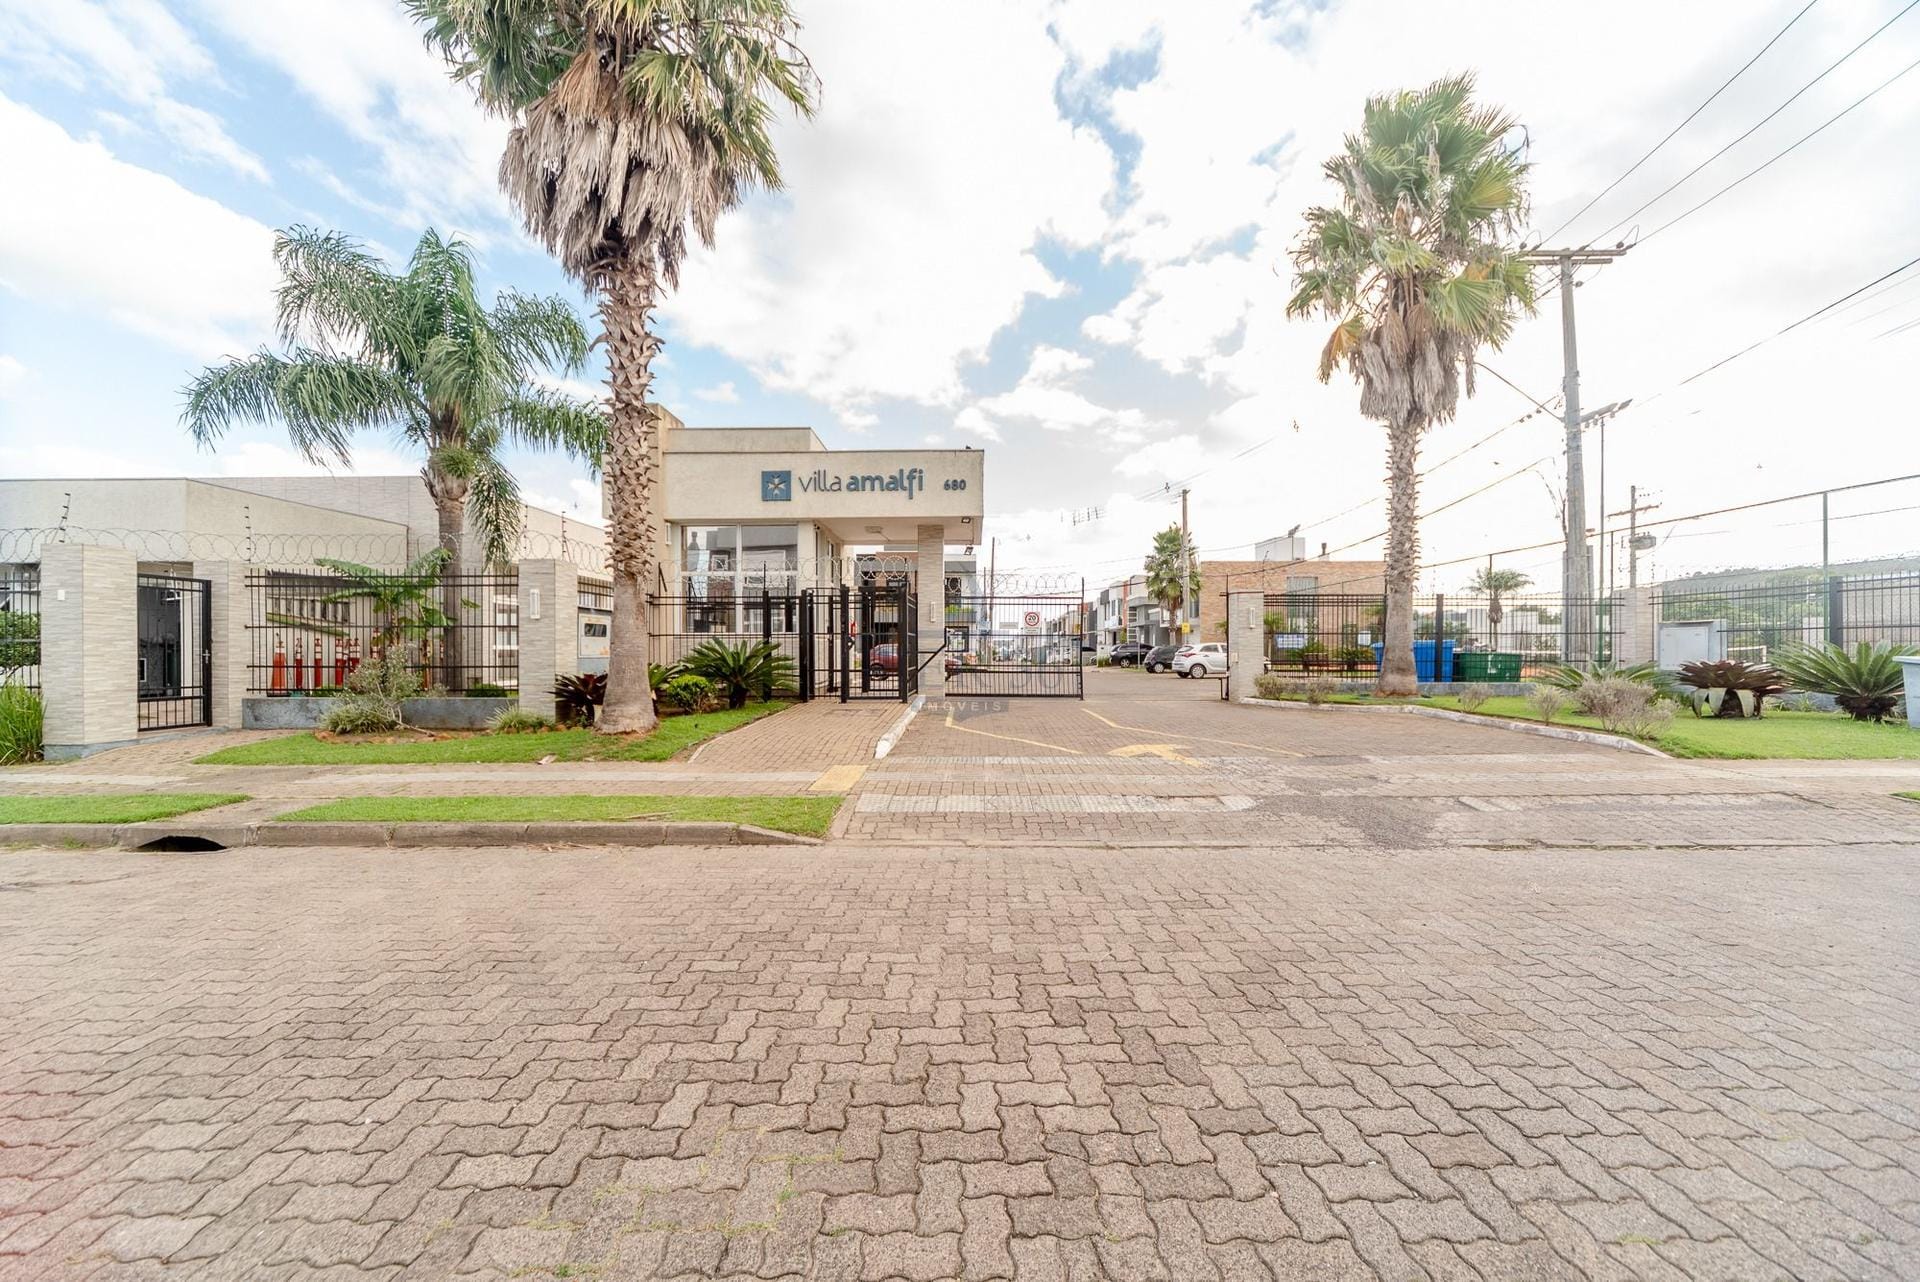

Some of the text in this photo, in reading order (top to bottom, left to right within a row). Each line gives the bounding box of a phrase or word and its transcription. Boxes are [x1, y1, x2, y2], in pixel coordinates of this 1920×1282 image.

[798, 468, 924, 500] villa amalfi
[943, 479, 967, 491] 680
